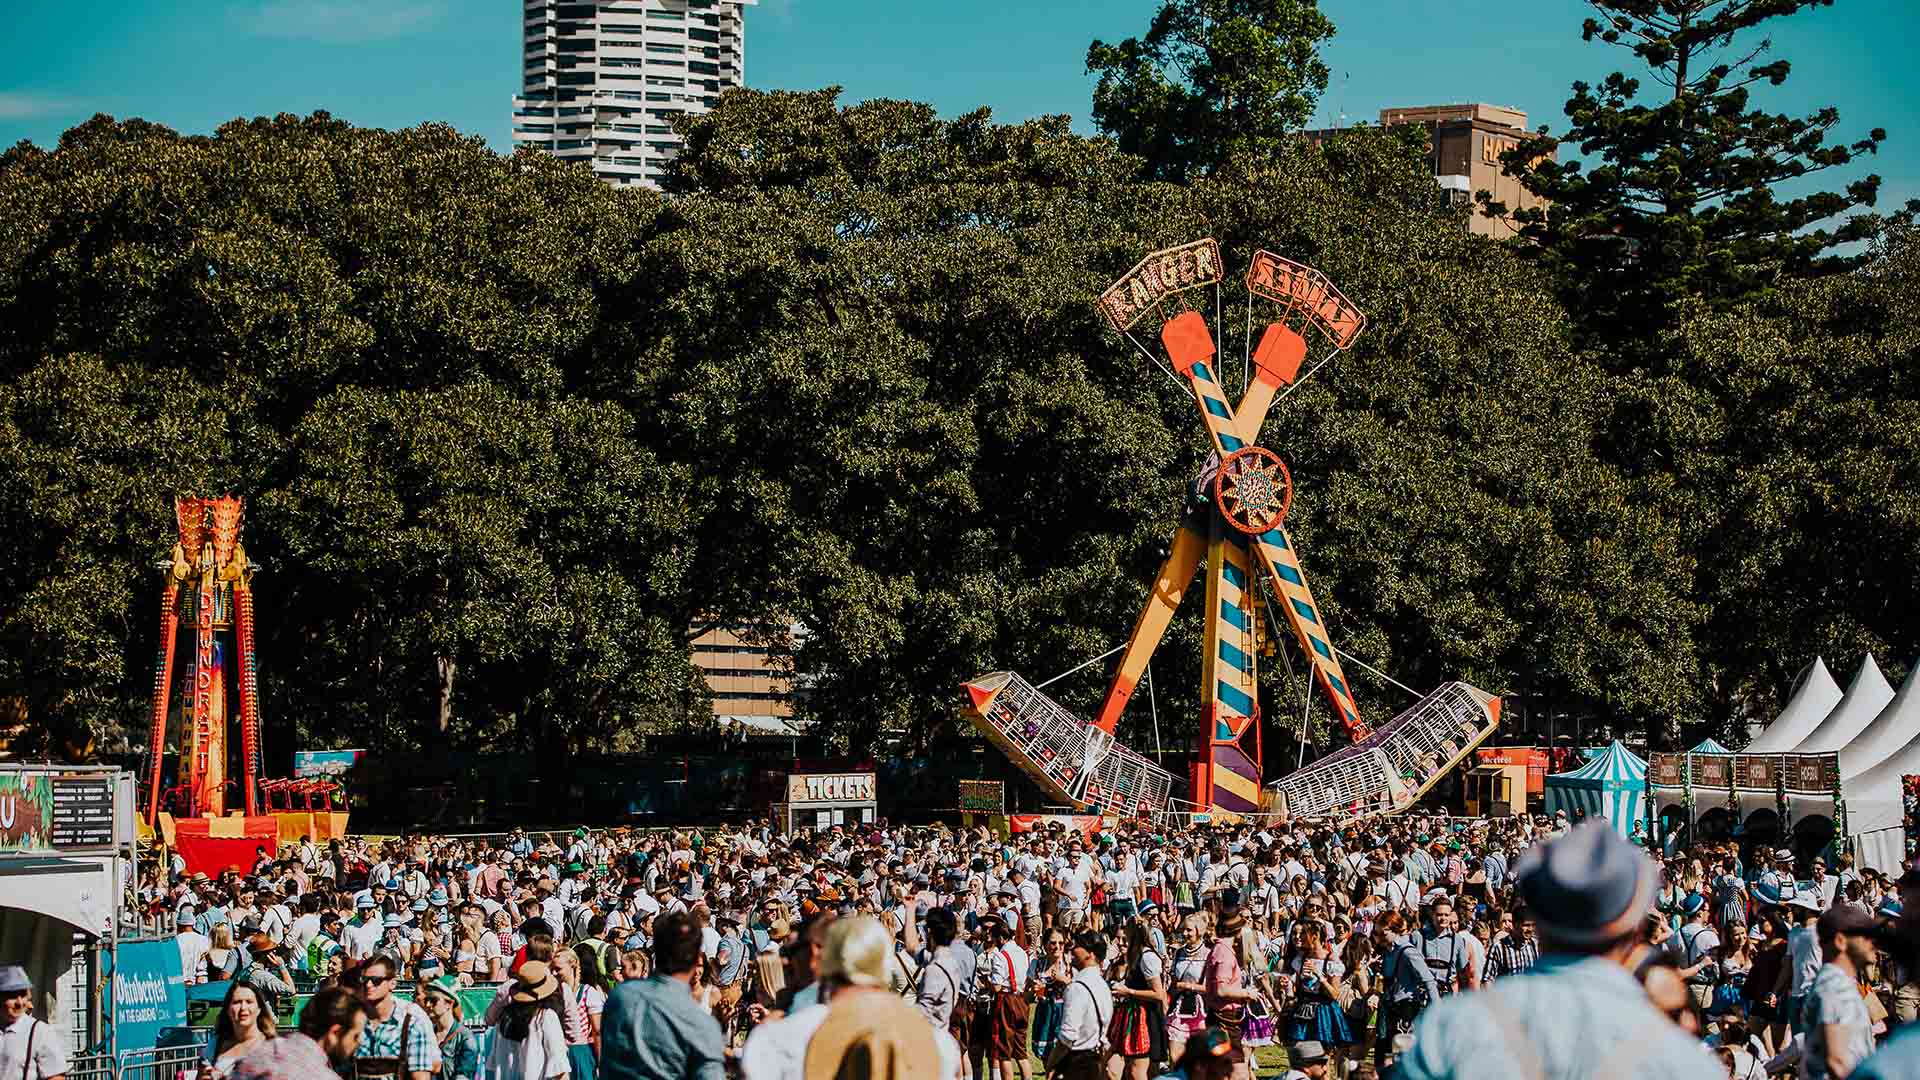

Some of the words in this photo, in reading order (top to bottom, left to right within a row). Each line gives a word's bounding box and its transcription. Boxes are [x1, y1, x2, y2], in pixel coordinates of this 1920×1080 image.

[1106, 246, 1216, 324] RANGER
[197, 591, 214, 769] DOWNDRAFT
[806, 775, 873, 800] TICKETS
[116, 972, 167, 1008] Oktoberfest
